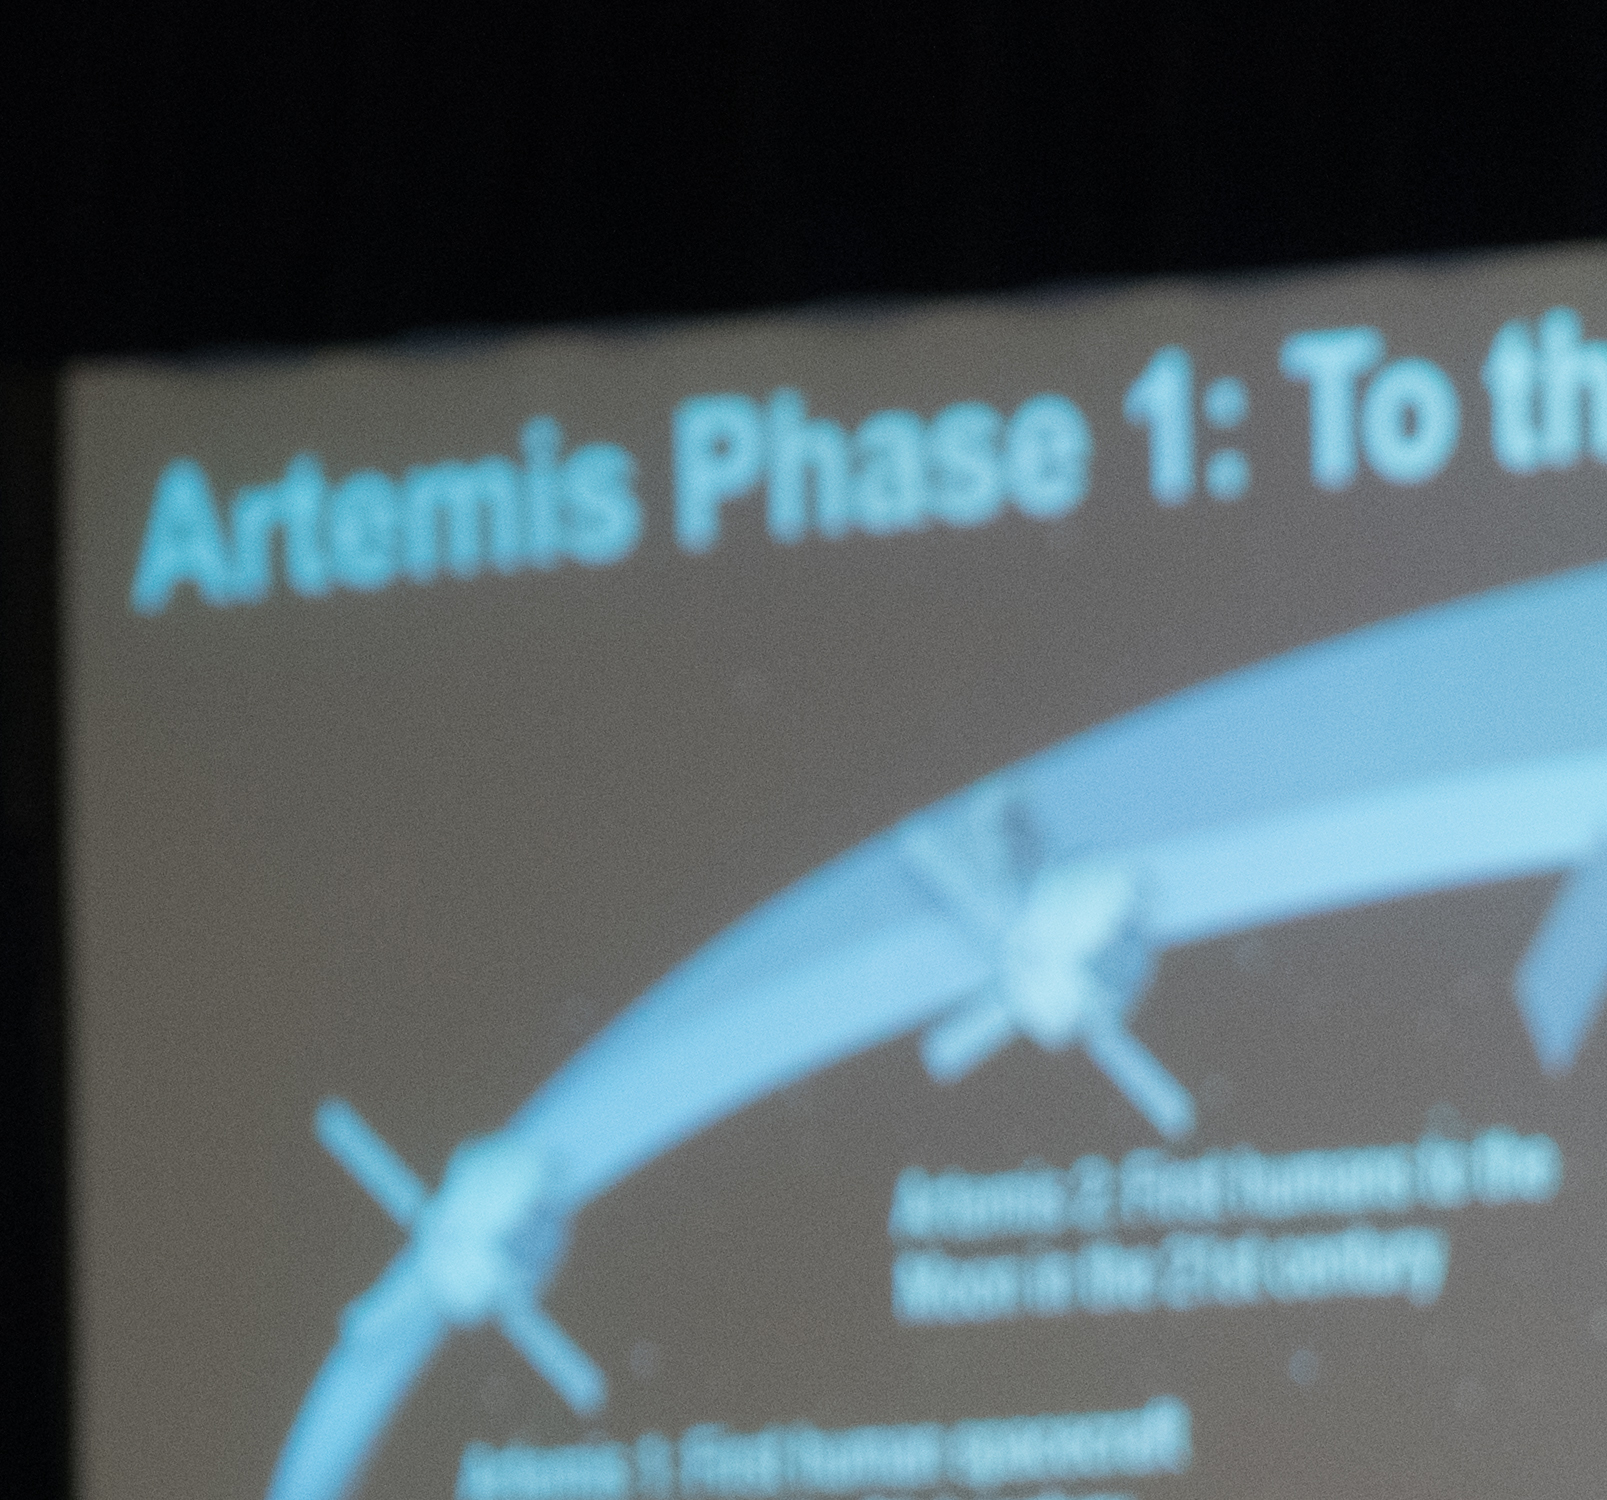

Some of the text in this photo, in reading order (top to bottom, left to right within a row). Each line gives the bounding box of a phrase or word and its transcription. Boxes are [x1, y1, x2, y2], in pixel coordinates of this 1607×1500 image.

[129, 417, 645, 613] Artemis
[675, 390, 1089, 554] Phase
[1123, 346, 1250, 503] 1:
[1280, 326, 1460, 492] To
